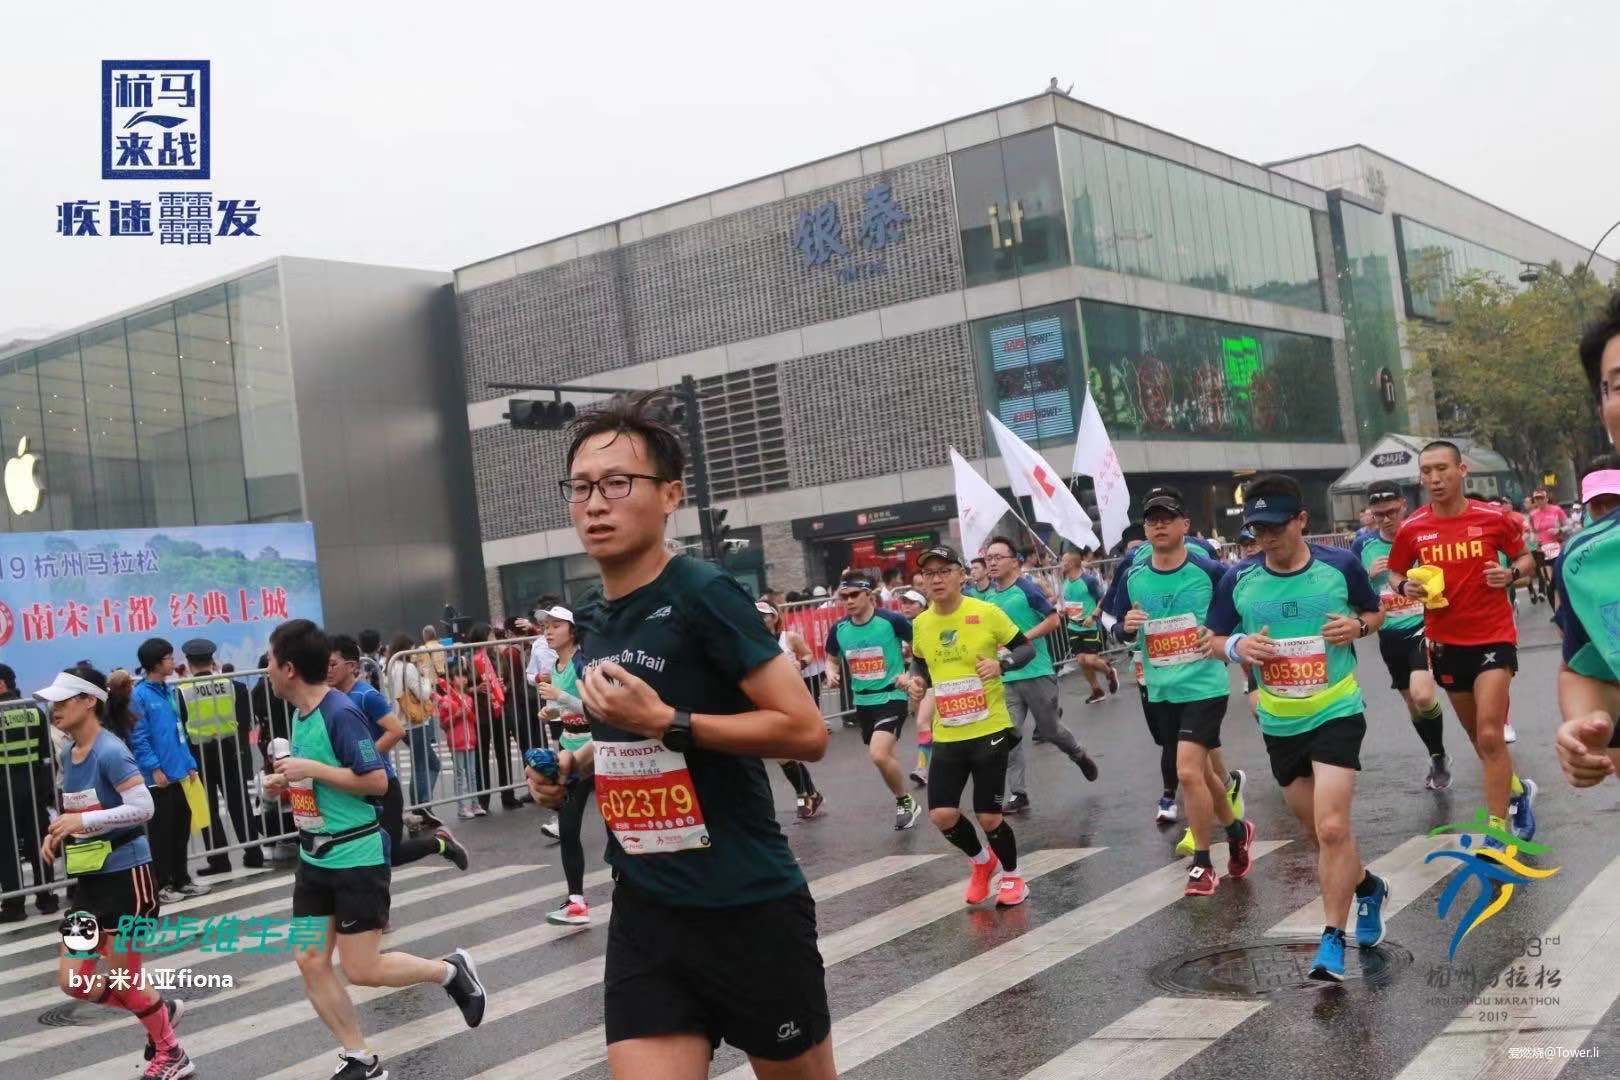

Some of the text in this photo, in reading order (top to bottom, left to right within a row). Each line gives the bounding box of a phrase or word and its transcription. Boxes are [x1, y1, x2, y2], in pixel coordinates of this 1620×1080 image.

[796, 182, 912, 265] 银泰
[34, 549, 159, 579] 杭州马拉松
[1420, 541, 1483, 564] CHINA
[22, 586, 289, 642] 南宋古都 经典上城
[621, 648, 634, 664] On
[636, 649, 666, 673] Trail
[195, 682, 226, 695] POLCE
[620, 744, 665, 757] HONDA
